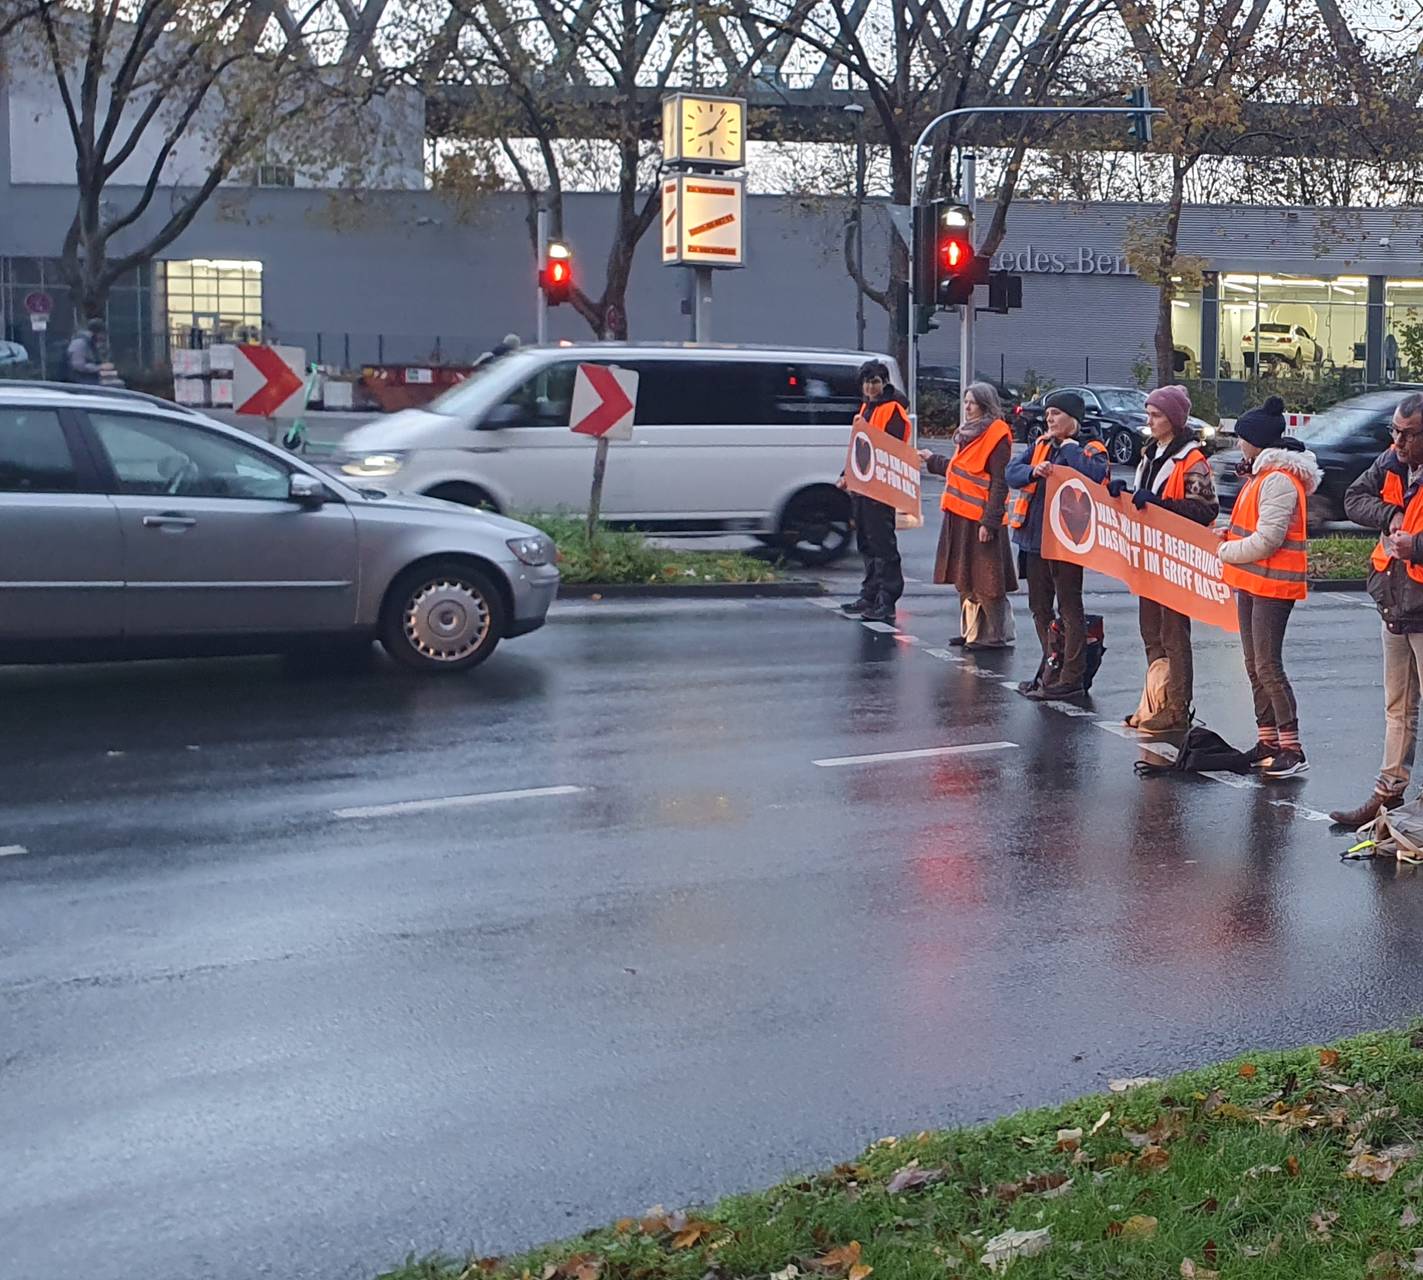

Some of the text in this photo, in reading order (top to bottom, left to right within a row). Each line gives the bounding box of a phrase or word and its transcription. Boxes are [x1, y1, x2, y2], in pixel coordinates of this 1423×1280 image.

[1097, 525, 1119, 552] DAS
[1144, 548, 1161, 576] IM
[1162, 558, 1195, 592] GRIFF
[1194, 572, 1231, 605] HAT?
[1143, 523, 1164, 551] DIE
[1164, 533, 1224, 581] REGIERUNG
